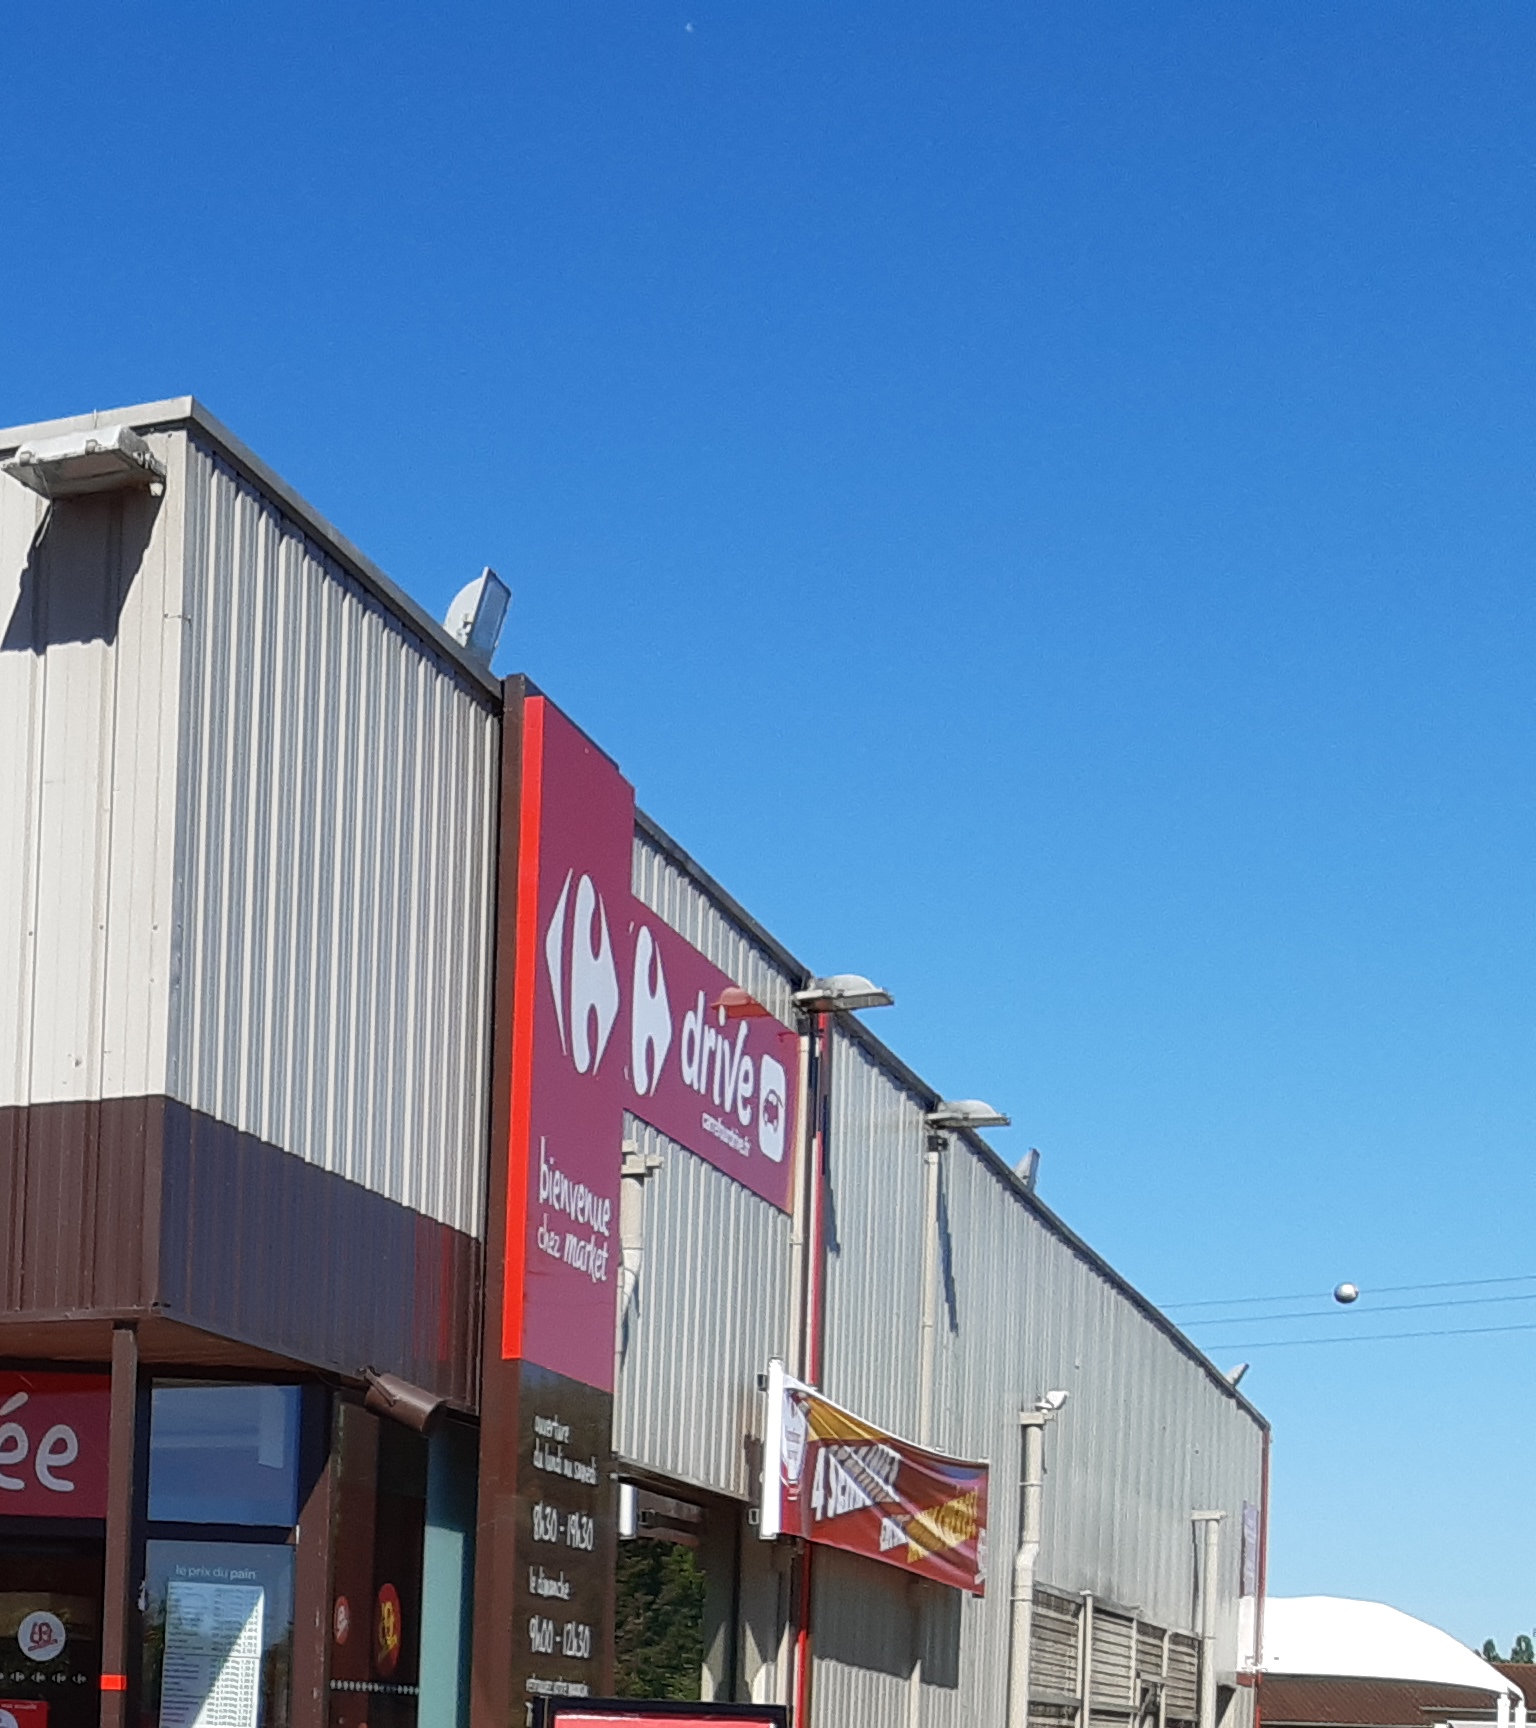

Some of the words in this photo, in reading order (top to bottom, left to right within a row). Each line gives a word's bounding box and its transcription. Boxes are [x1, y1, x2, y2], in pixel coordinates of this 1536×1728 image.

[681, 989, 754, 1126] drive
[539, 1136, 612, 1237] bienvenue
[538, 1213, 561, 1258] chez
[564, 1234, 609, 1283] market
[533, 1500, 558, 1543] 8h30
[566, 1511, 593, 1551] 19h30
[188, 1566, 210, 1577] prix
[212, 1566, 228, 1577] du
[229, 1567, 256, 1581] pain
[530, 1614, 554, 1653] 9h00
[562, 1620, 591, 1659] 12h30
